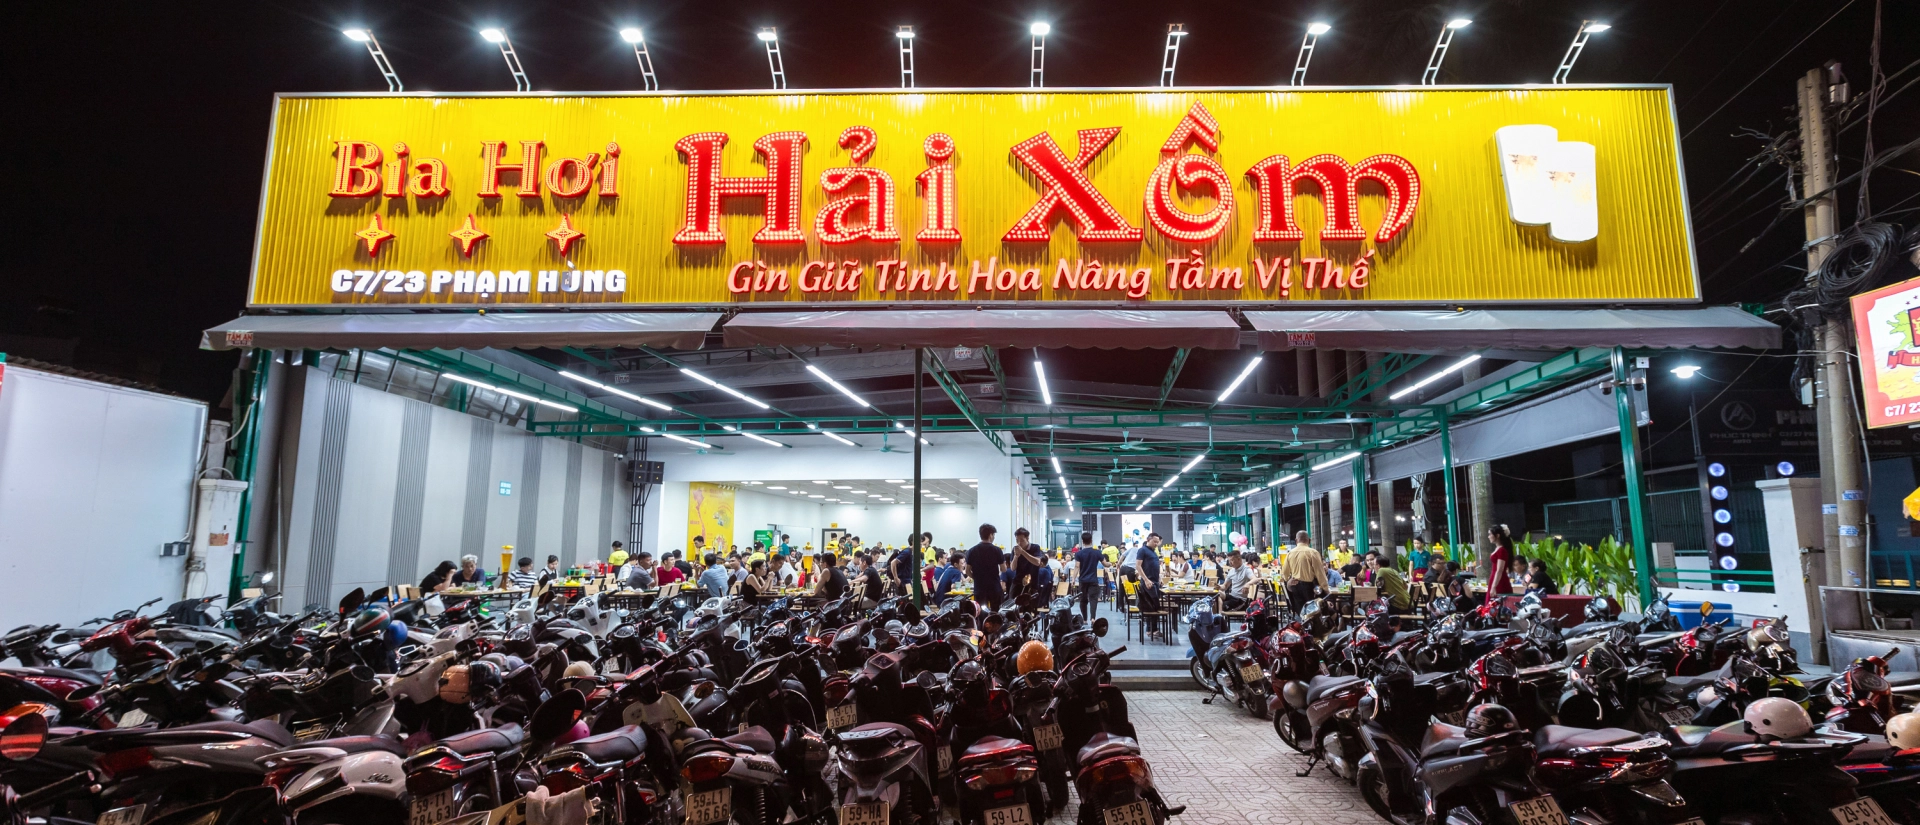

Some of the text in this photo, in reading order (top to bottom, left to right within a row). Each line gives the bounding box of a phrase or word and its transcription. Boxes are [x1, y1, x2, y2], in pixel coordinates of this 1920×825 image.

[328, 140, 620, 198] Bia Hơi
[672, 99, 1421, 243] Hải Xôm
[331, 261, 626, 298] C7/23 PHẠM HÙNG
[726, 249, 1375, 298] Gìn Giữ Tinh Hoa Nâng Tầm Vị Thế
[1884, 403, 1906, 417] C7/
[1038, 736, 1060, 749] 160.7
[417, 792, 446, 814] 59-T1
[693, 790, 723, 809] 59-L1
[1517, 798, 1553, 817] 59-B1
[849, 804, 881, 821] 59-HA
[991, 807, 1024, 825] 59-L2
[1110, 803, 1144, 823] 55-P9
[1839, 801, 1876, 823] 29-G1
